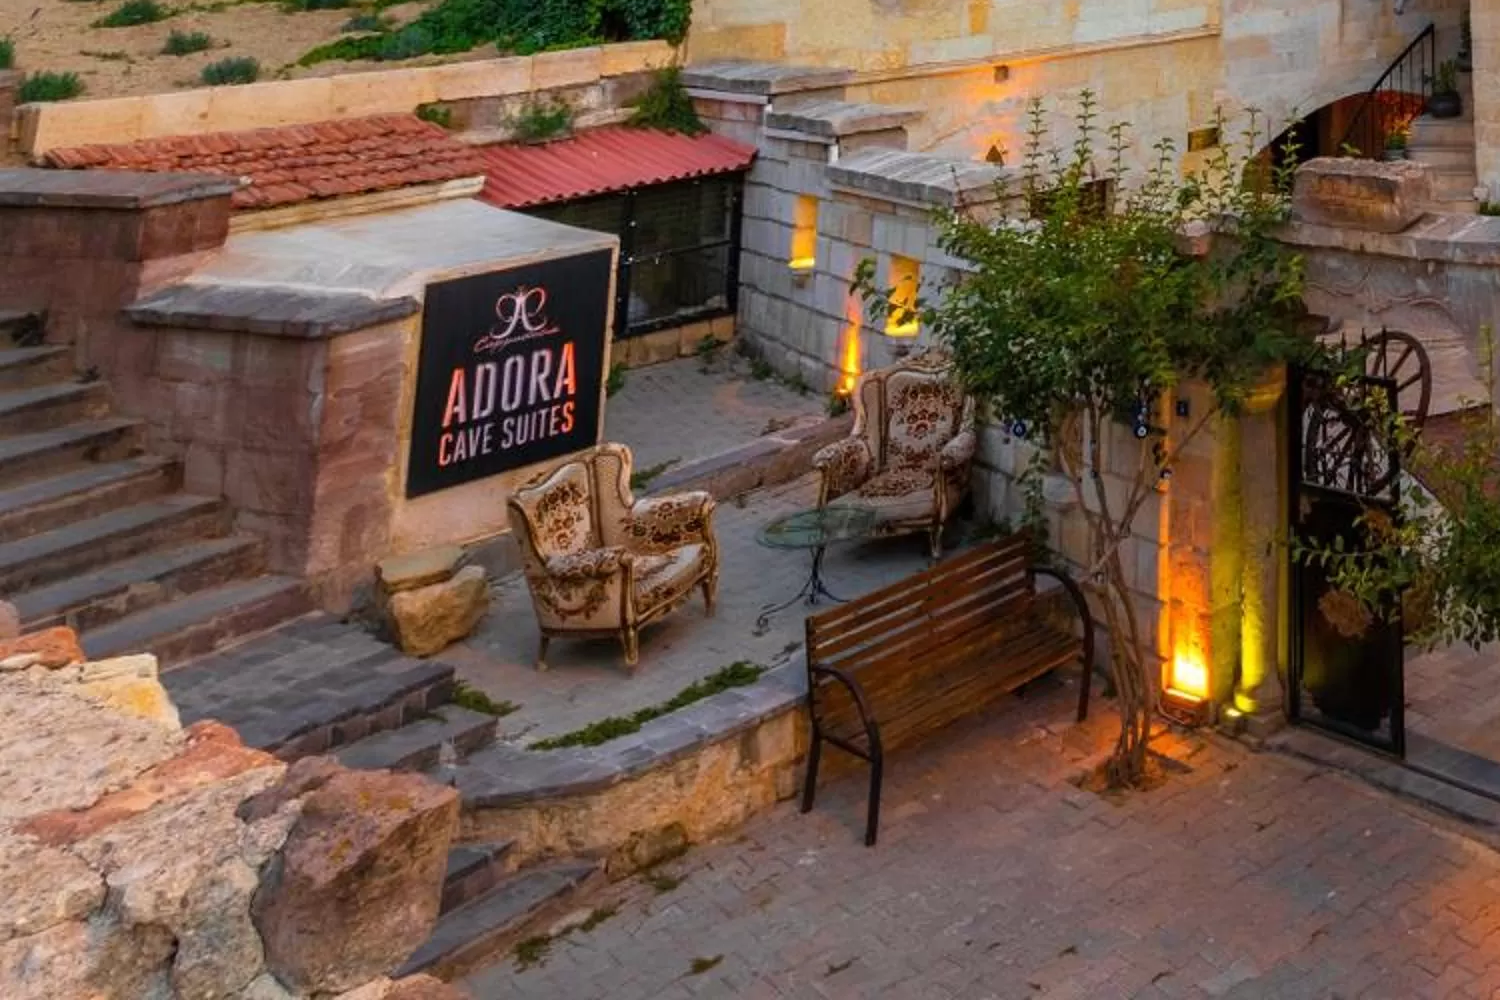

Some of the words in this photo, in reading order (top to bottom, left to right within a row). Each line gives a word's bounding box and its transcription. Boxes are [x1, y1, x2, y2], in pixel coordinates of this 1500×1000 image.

[441, 342, 577, 428] ADORA
[438, 424, 494, 467] CAVE
[501, 401, 576, 449] SUITES
